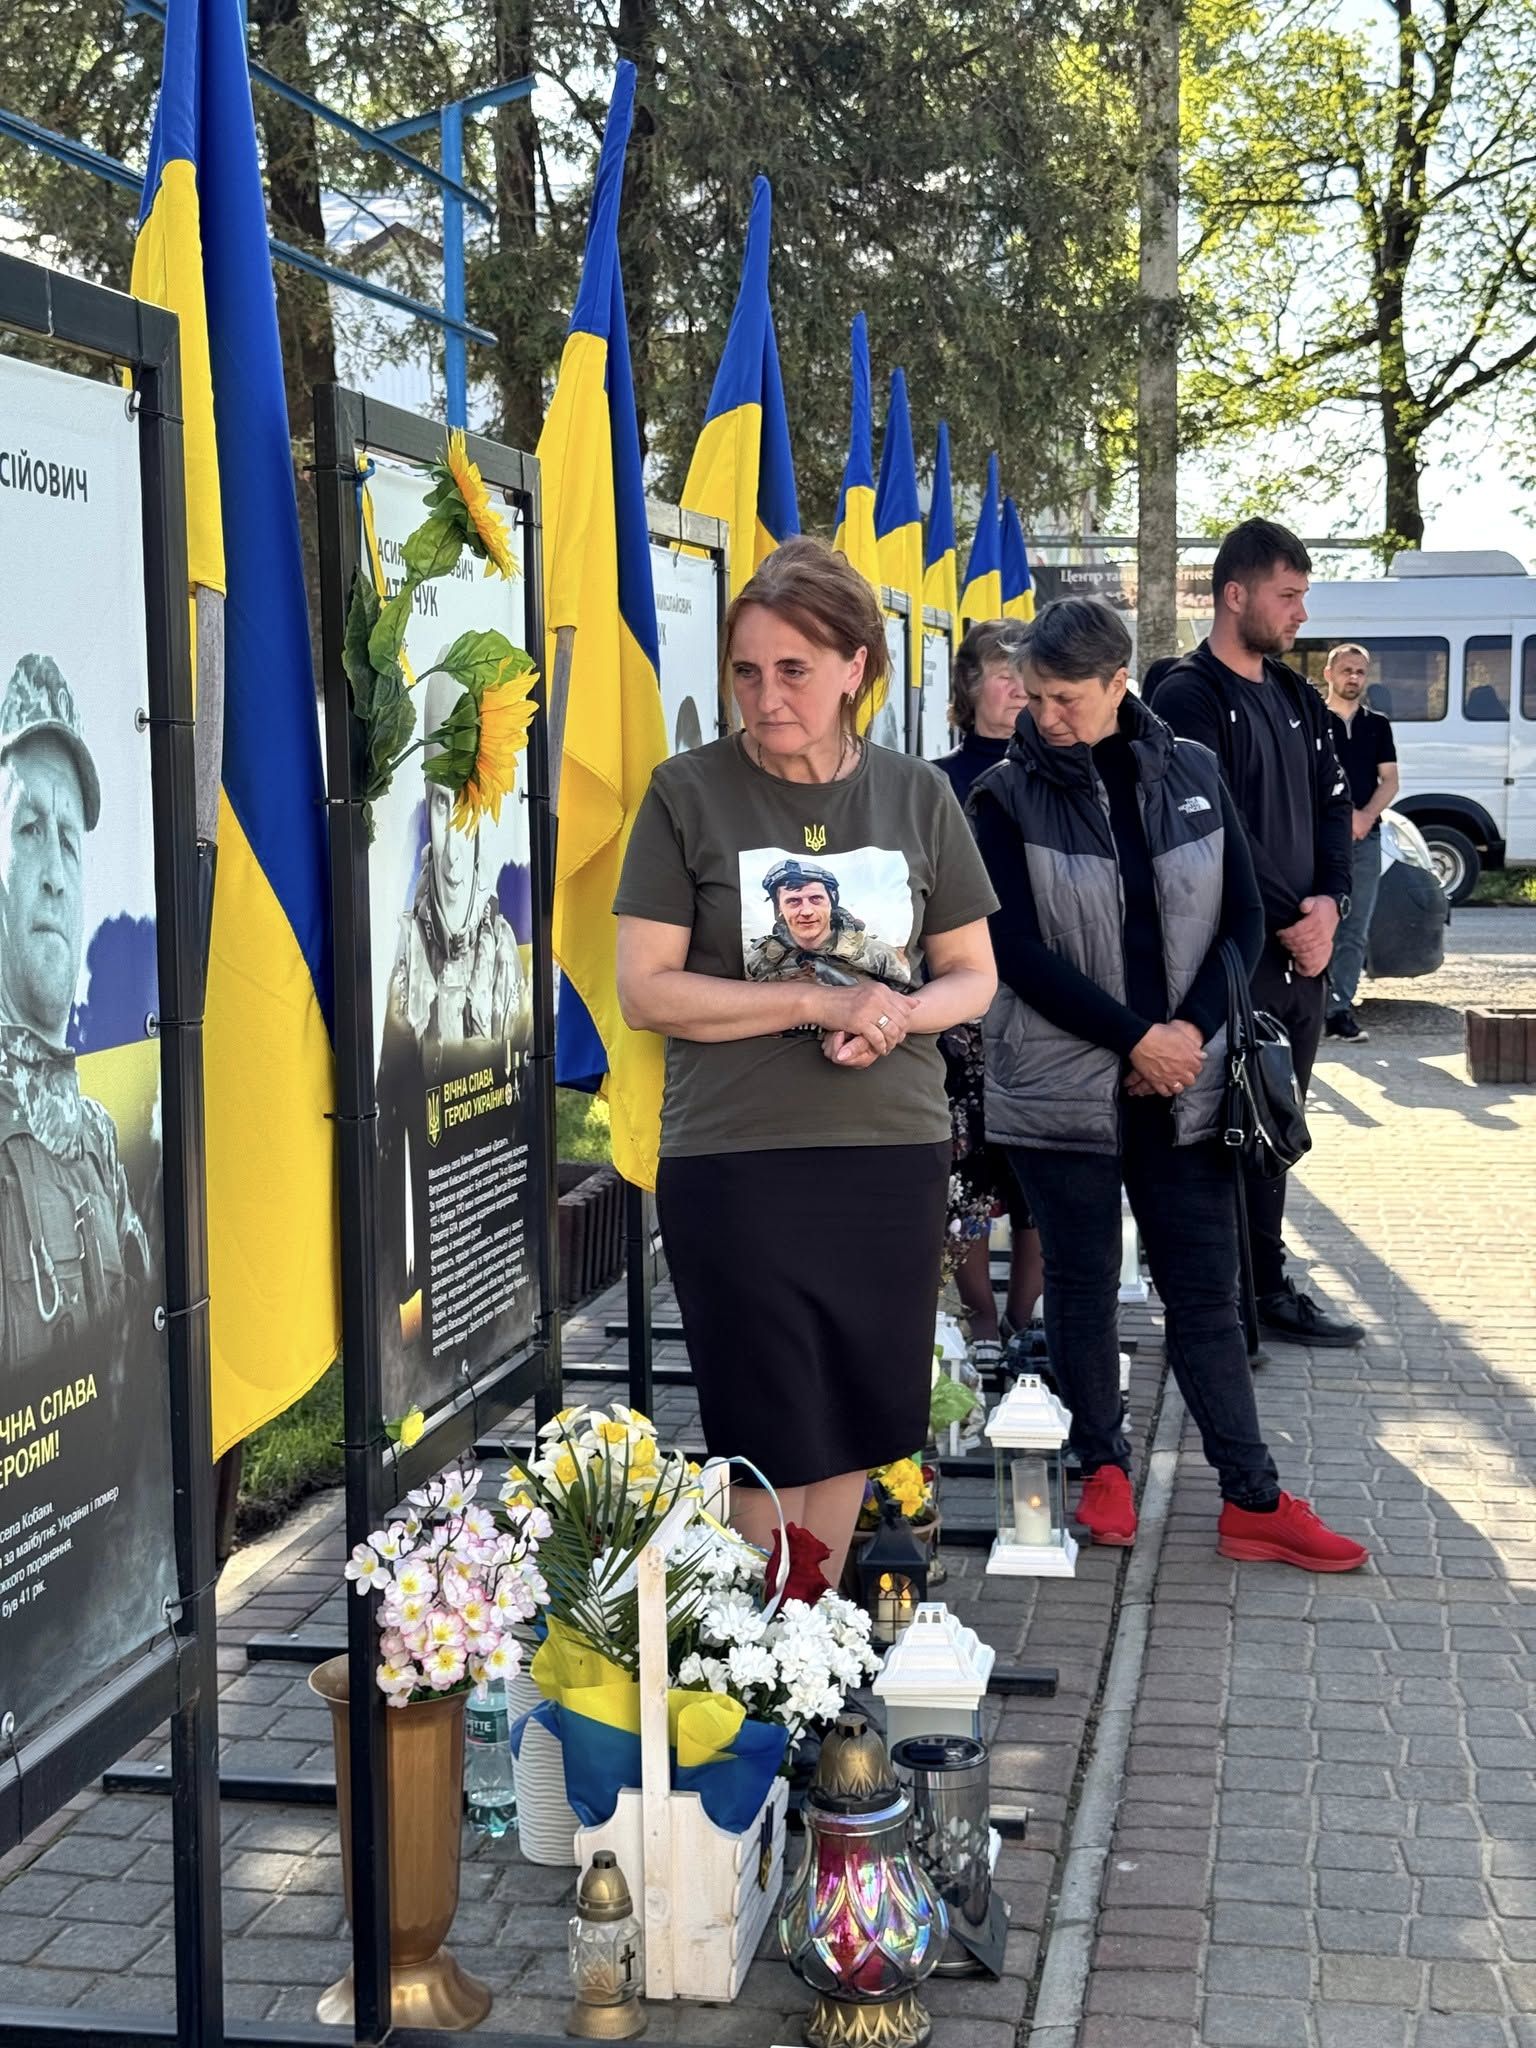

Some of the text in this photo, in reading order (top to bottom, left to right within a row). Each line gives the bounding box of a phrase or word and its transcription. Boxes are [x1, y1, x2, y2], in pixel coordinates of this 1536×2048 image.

[0, 448, 88, 503] СІЙОВИЧ
[1060, 568, 1103, 586] Центр
[443, 1067, 494, 1103] ВІЧНА СЛАВА
[444, 1099, 472, 1129] ГЕРОЮ
[40, 1373, 98, 1425] СЛАВА
[57, 1504, 89, 1533] України
[2, 1597, 19, 1618] був
[19, 1586, 30, 1606] 41
